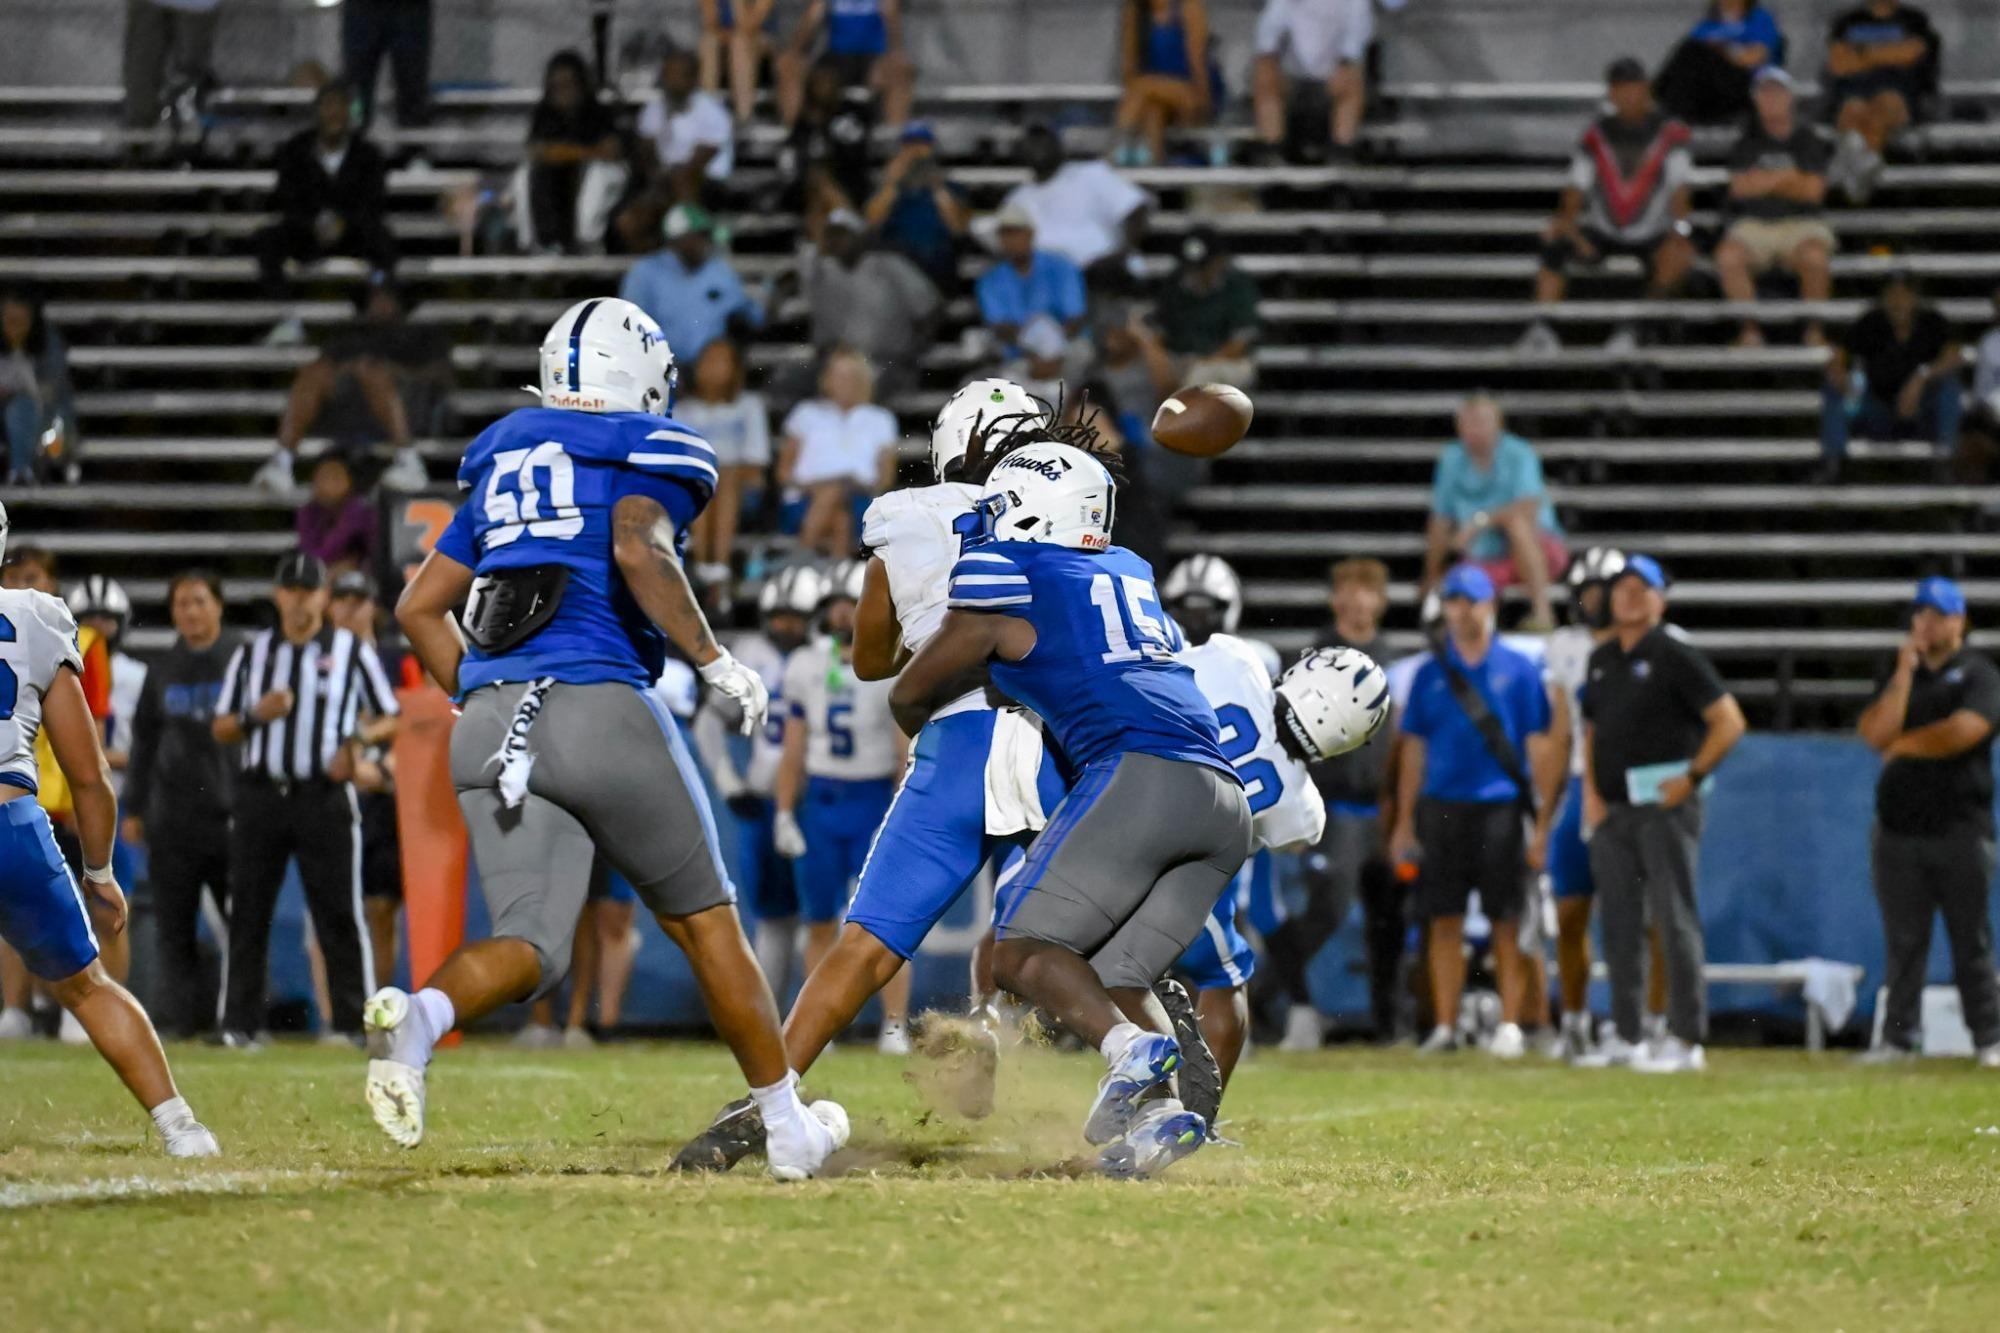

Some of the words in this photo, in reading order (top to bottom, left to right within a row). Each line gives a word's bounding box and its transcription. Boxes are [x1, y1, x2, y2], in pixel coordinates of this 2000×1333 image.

[484, 441, 585, 549] 50
[998, 451, 1062, 482] Hawks
[1090, 573, 1175, 664] 15
[827, 702, 856, 758] 5
